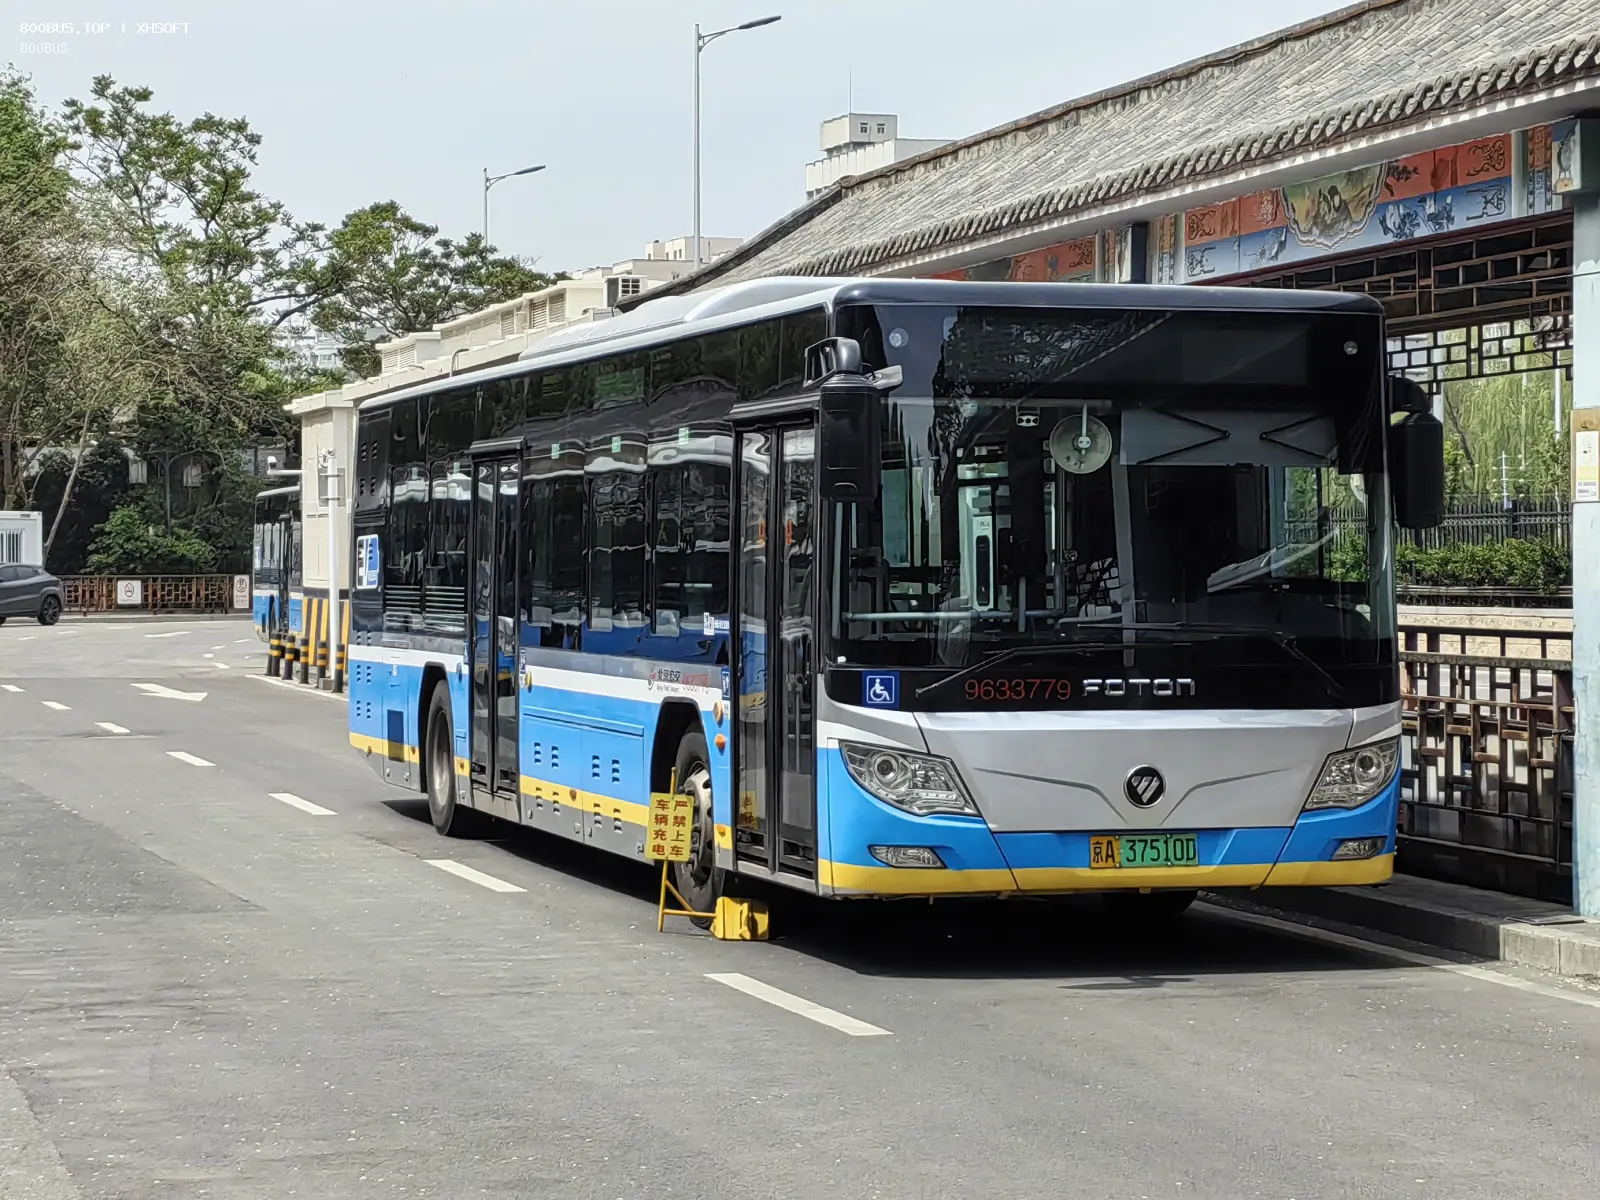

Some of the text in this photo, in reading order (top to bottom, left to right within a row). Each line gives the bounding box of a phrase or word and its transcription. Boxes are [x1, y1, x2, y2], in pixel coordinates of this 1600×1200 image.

[964, 678, 1072, 701] 9633779
[1082, 678, 1196, 697] FOTON
[652, 798, 670, 856] 车辆充电
[669, 800, 689, 857] 严禁上车
